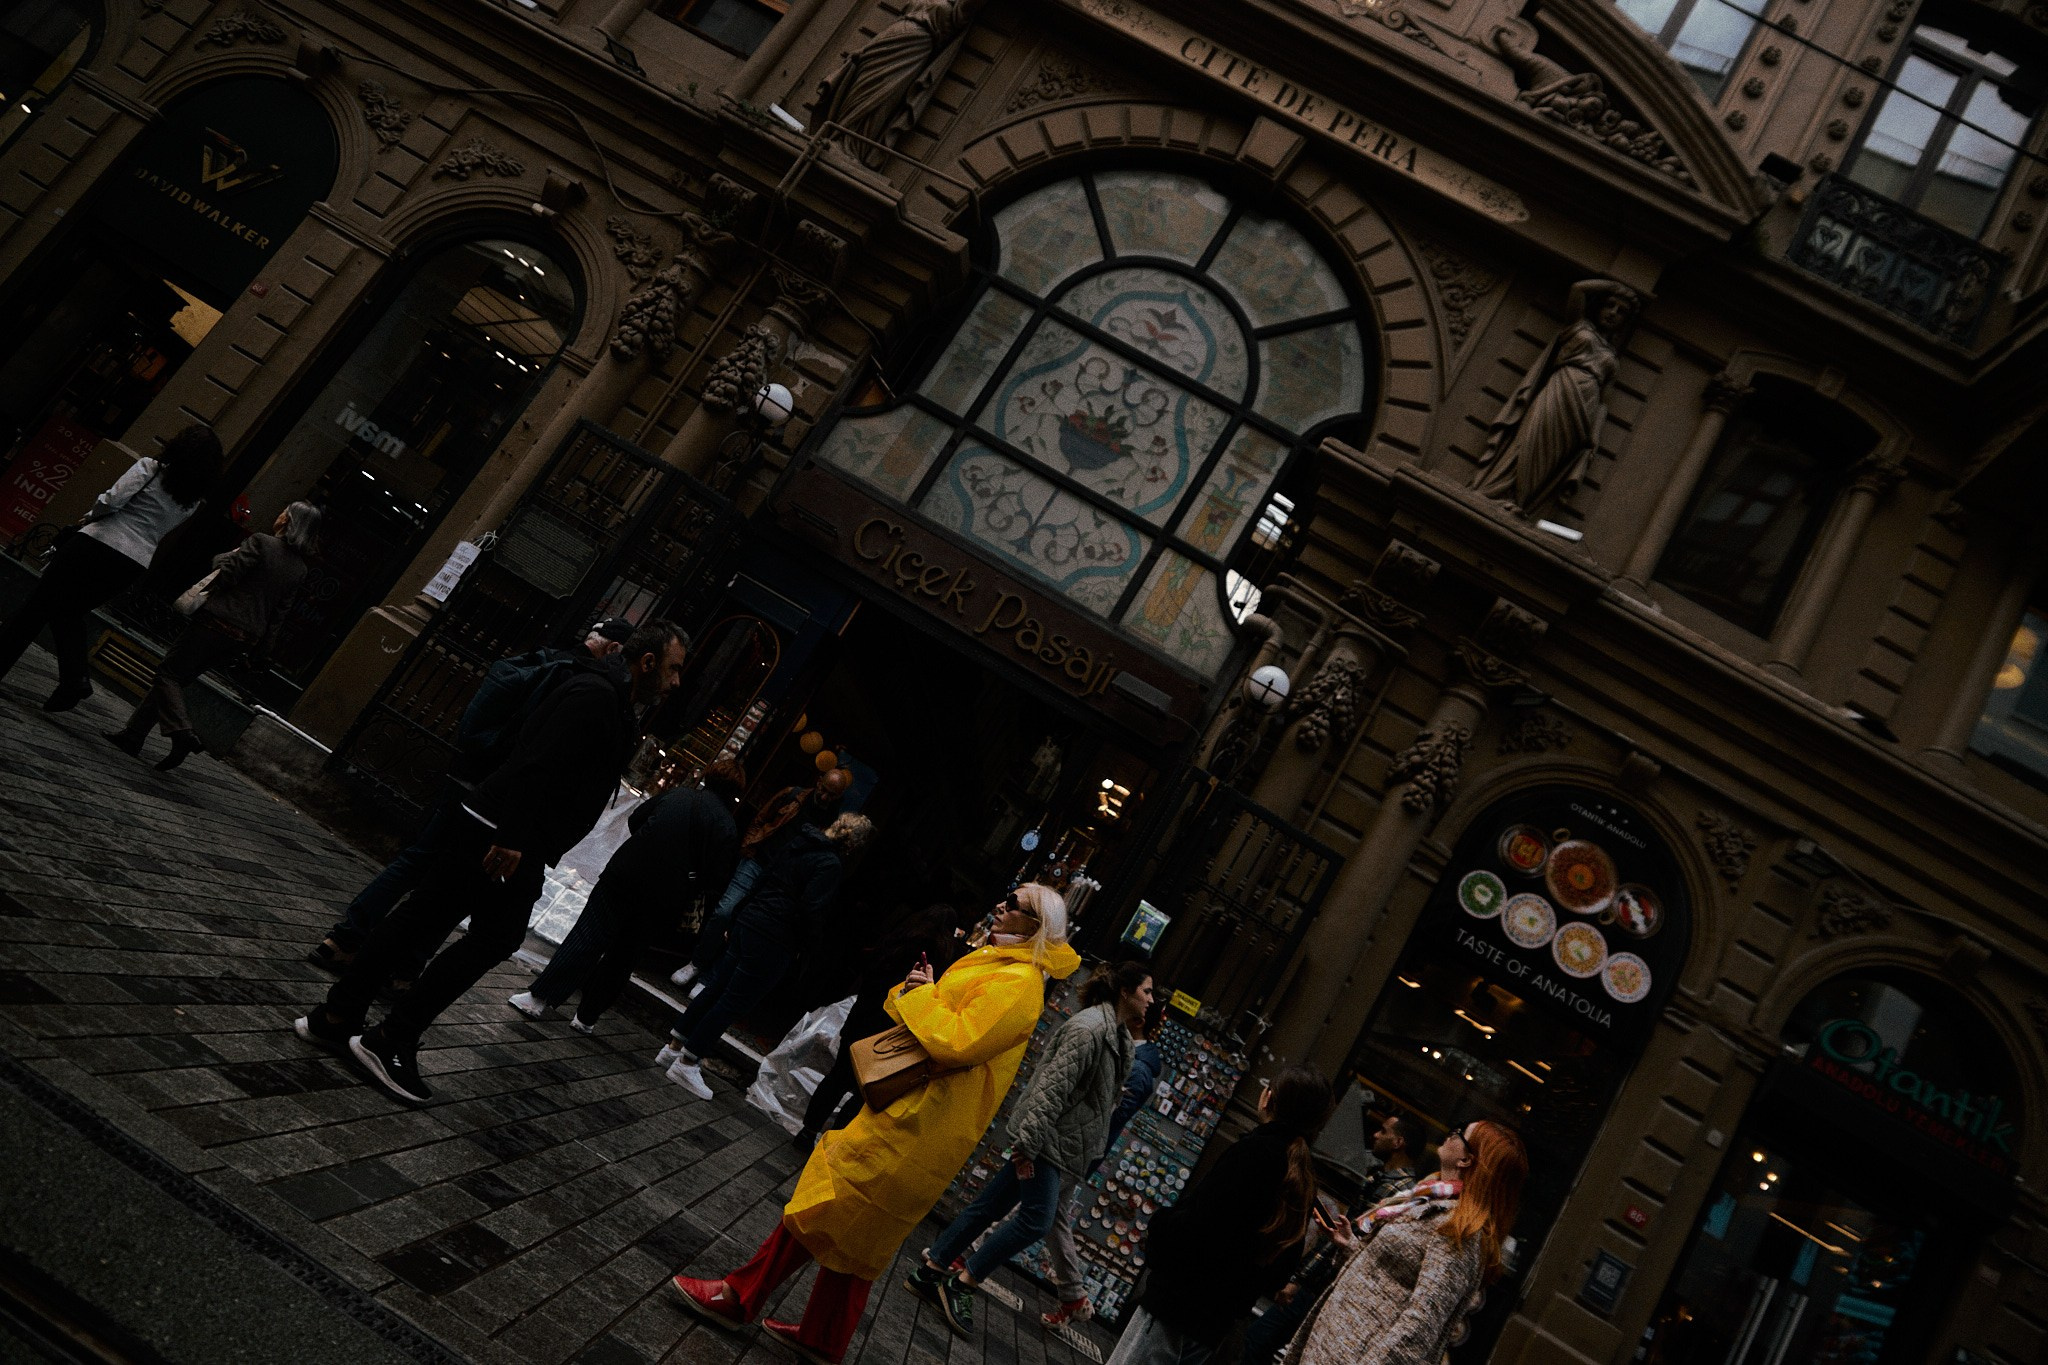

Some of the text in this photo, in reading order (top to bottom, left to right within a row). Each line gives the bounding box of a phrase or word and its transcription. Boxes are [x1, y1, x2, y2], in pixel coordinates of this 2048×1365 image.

[1273, 81, 1326, 123] DE
[28, 460, 74, 492] %2
[1605, 823, 1647, 850] ANADOLU
[1456, 928, 1613, 1030] TASTE OF ANATOLIA
[1819, 1018, 2017, 1154] Otantik
